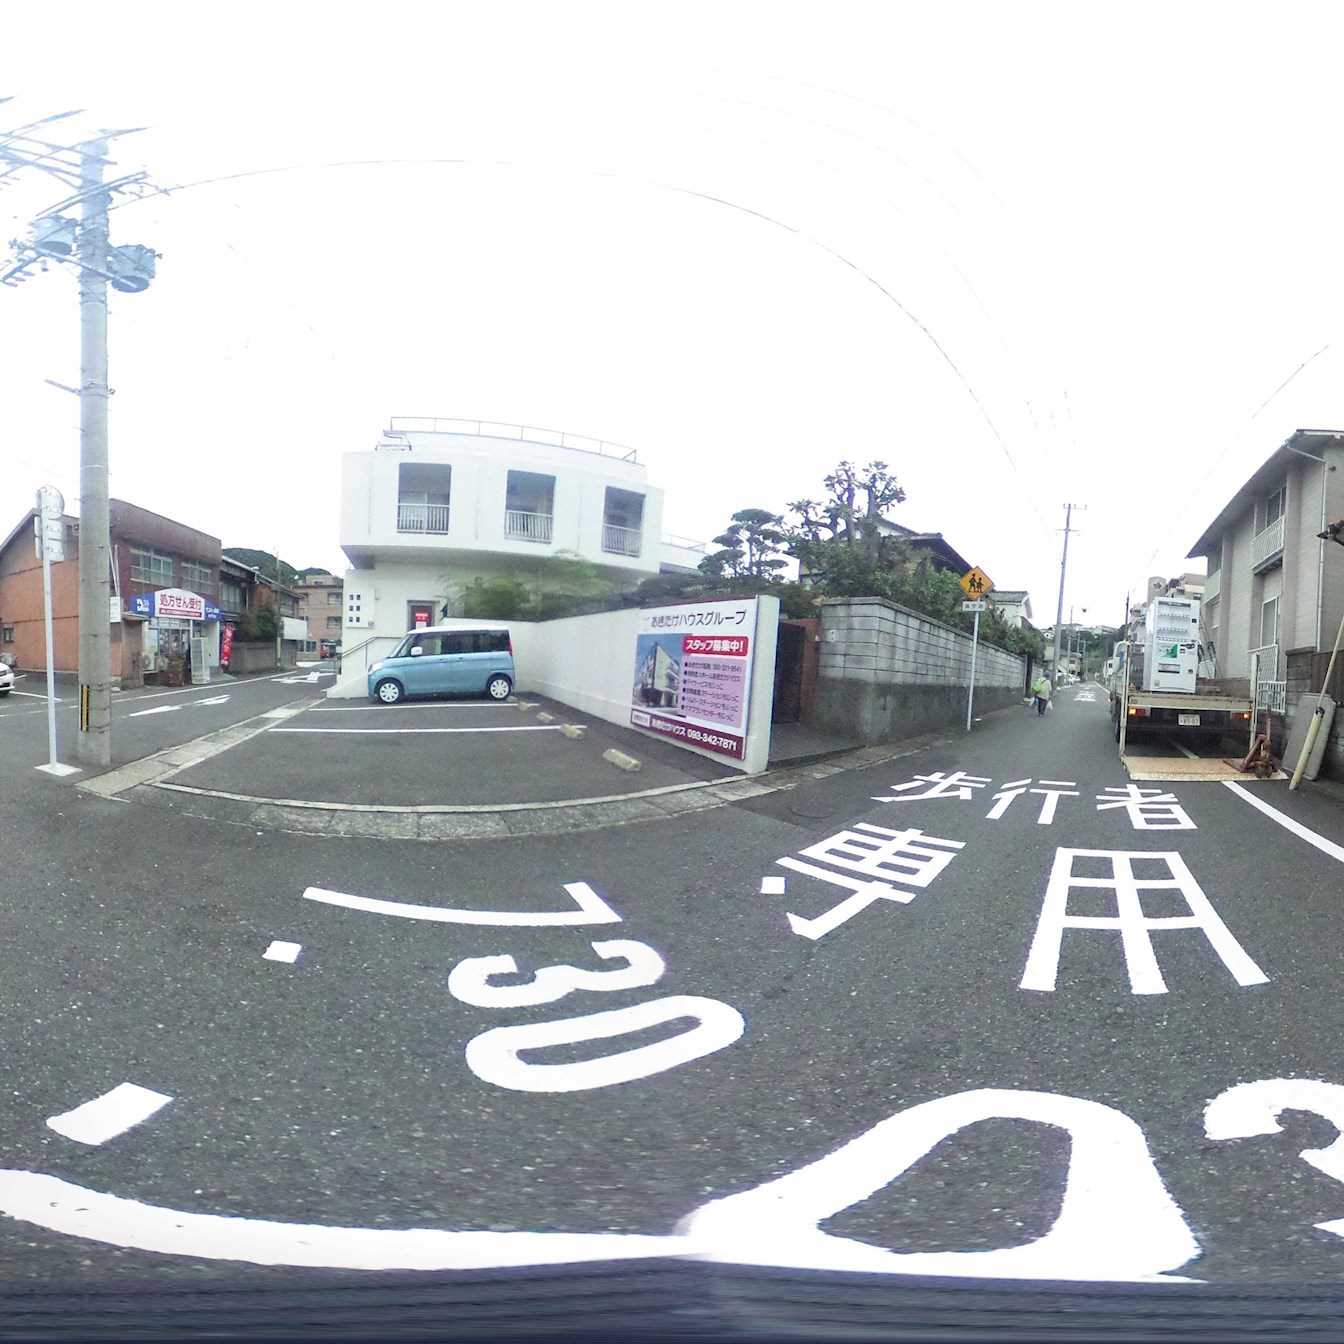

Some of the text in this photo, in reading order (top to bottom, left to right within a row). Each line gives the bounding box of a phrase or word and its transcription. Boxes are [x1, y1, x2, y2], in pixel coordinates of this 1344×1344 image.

[160, 593, 202, 610] 処方せん受付
[651, 610, 746, 628] おきたけハウスグループ
[871, 771, 1197, 830] 歩行者
